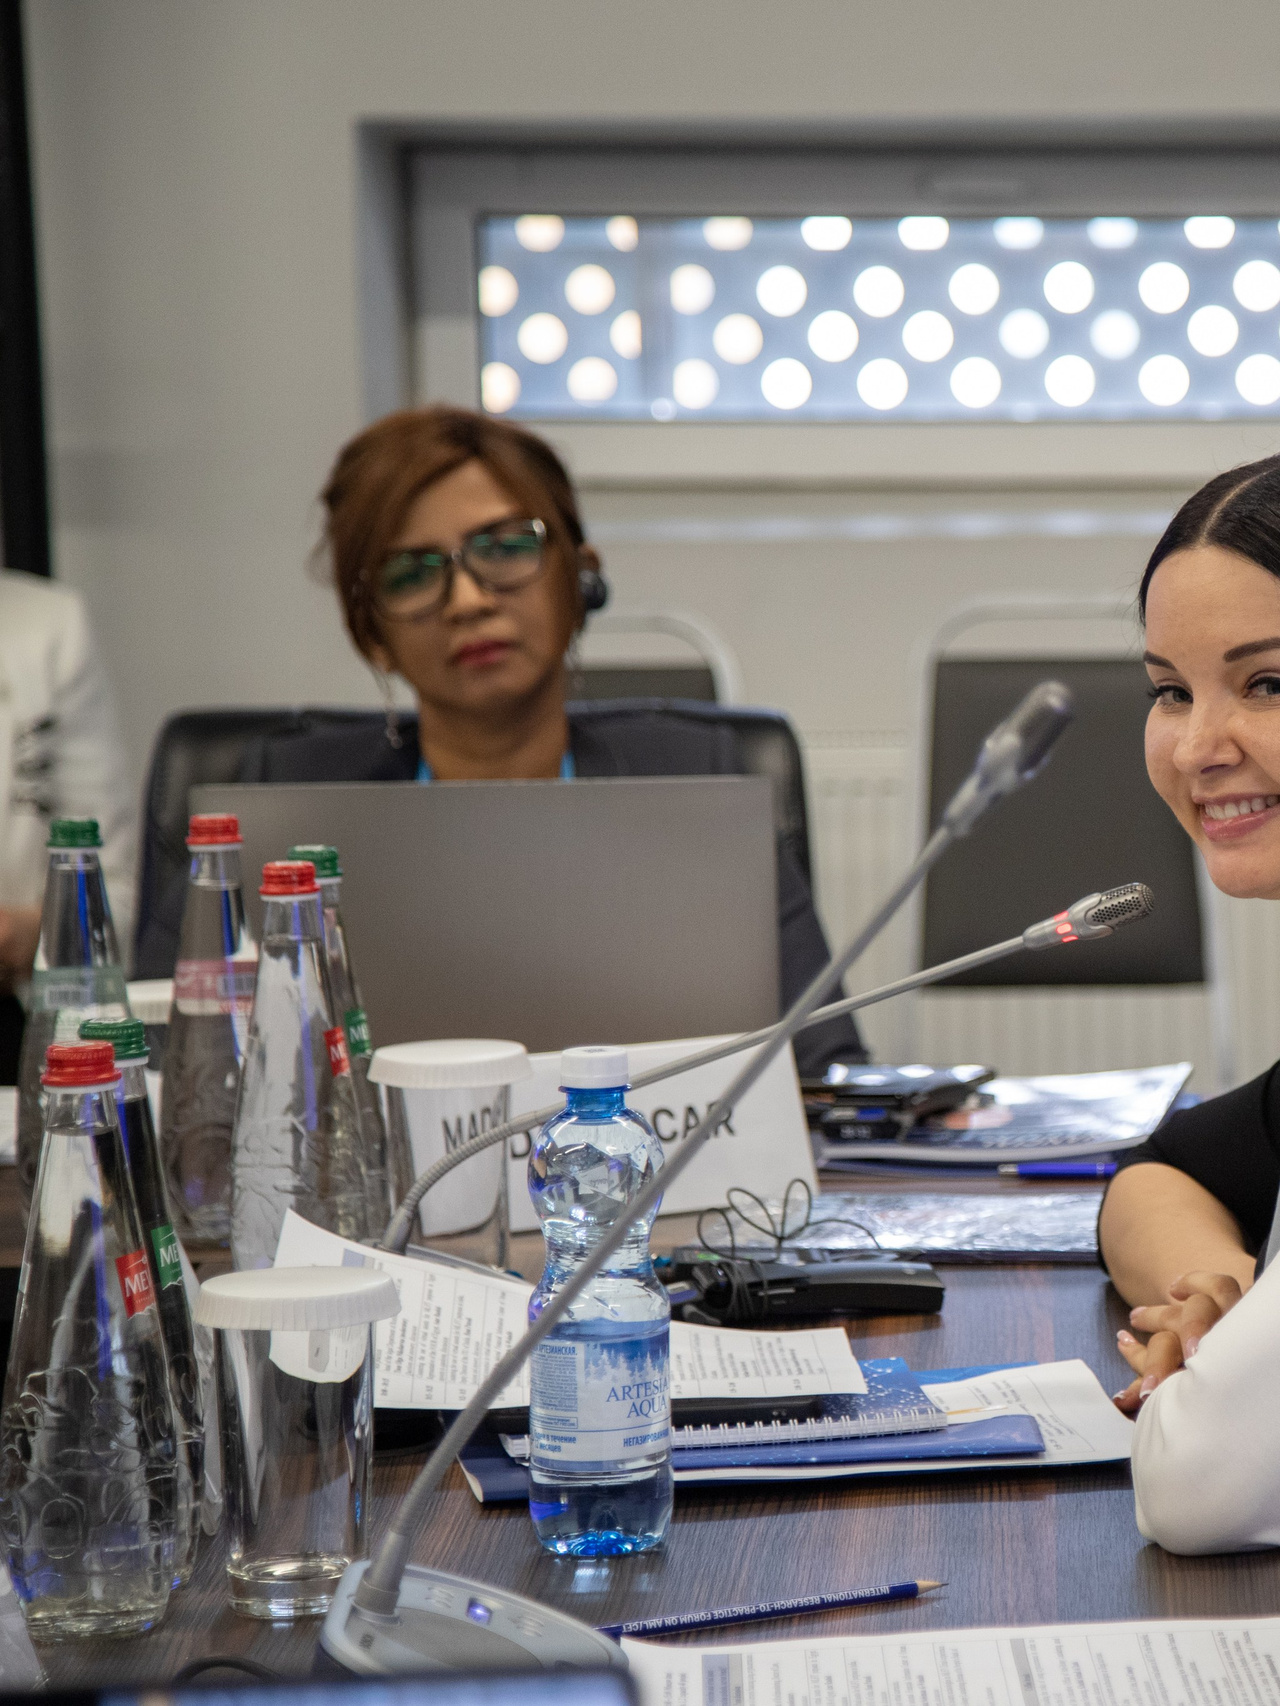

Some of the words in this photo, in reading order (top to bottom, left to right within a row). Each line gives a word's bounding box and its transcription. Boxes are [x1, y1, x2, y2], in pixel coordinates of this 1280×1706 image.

[626, 1394, 668, 1418] AQUA
[823, 1586, 890, 1604] INTERNATIONAL
[713, 1595, 821, 1619] RESEARCH-TO-PRACTICE
[665, 1617, 679, 1627] ON
[679, 1611, 712, 1625] FORUM
